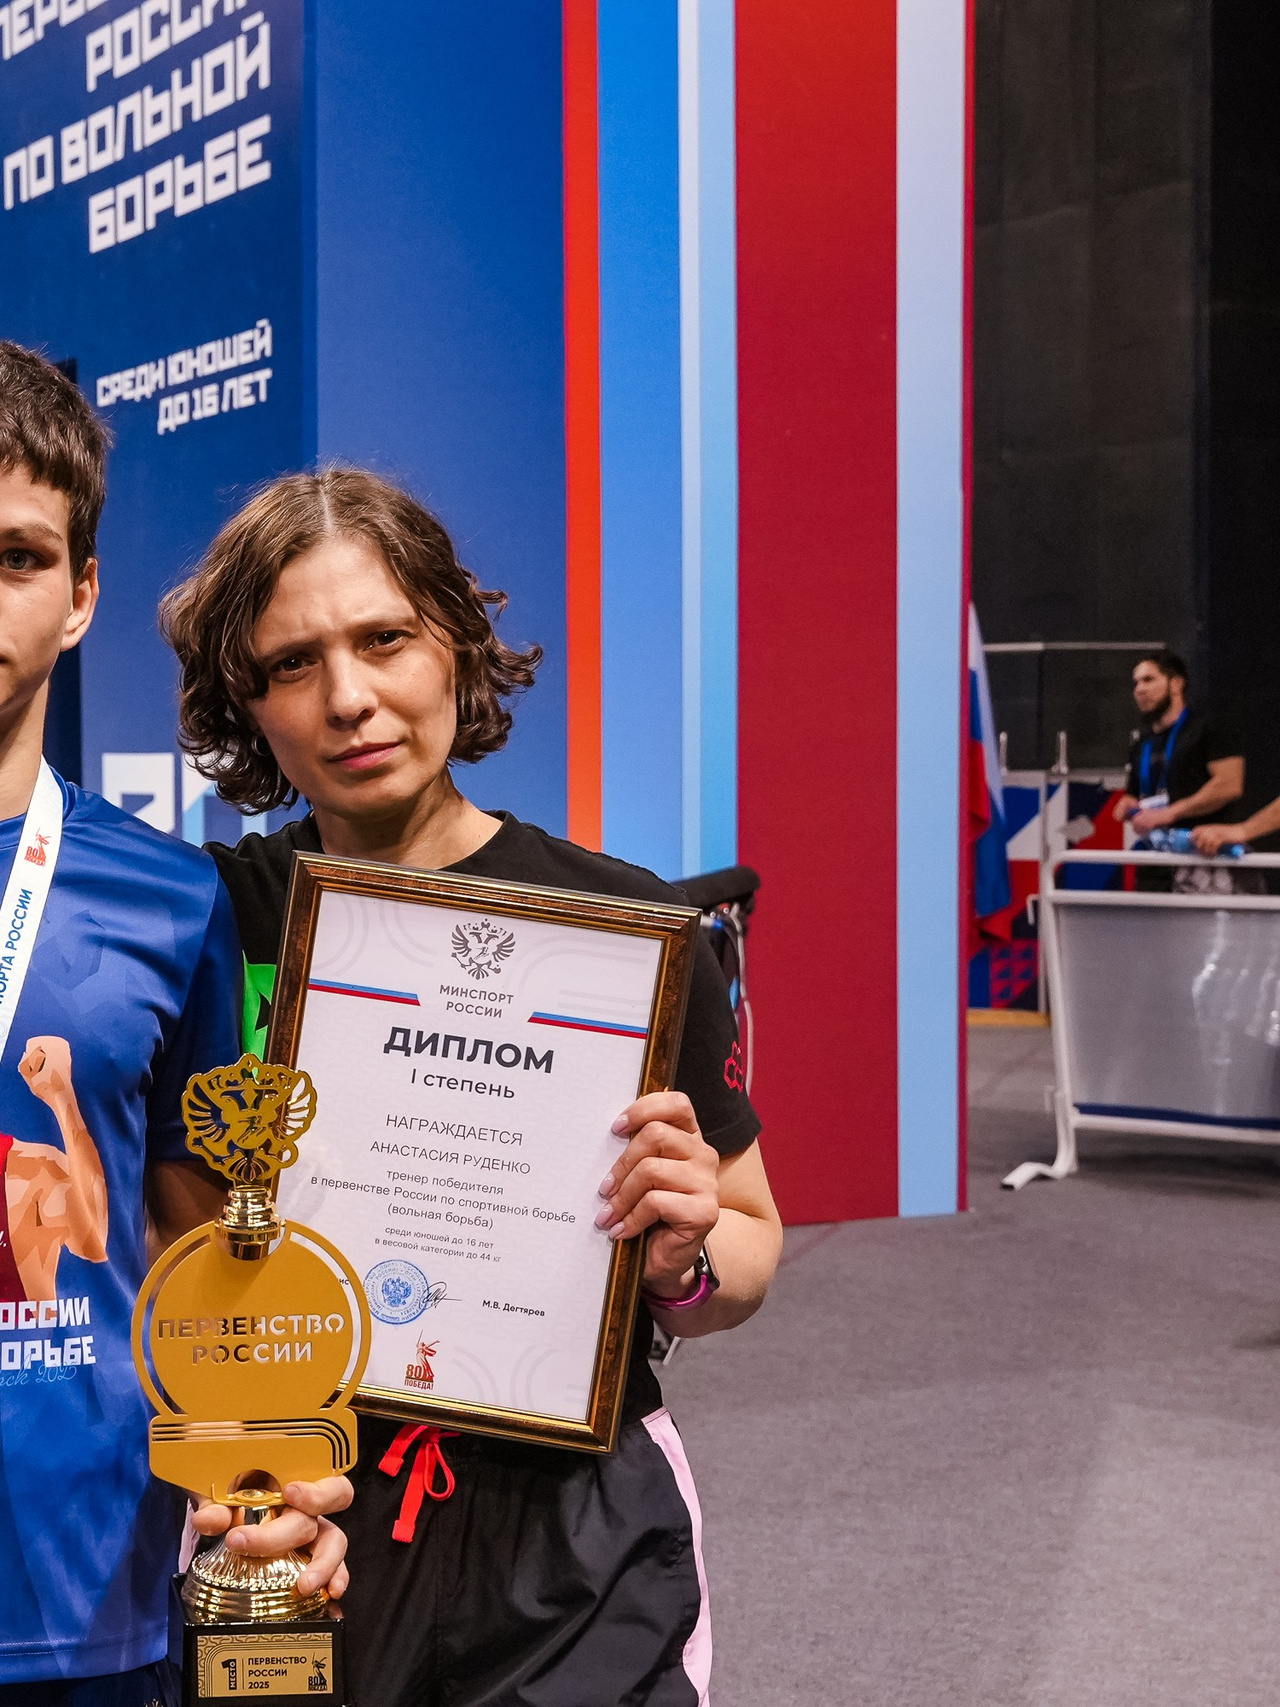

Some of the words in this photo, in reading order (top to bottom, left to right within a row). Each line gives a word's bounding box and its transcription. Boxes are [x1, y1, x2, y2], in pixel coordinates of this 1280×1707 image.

[2, 134, 54, 212] ПО
[60, 12, 270, 184] ВОЛЬНОЙ
[88, 114, 272, 254] БОРЬБЕ
[96, 358, 166, 408] СРЕДИ
[167, 318, 273, 387] ЮНОШЕЙ
[157, 389, 191, 435] ДО
[192, 384, 218, 419] 16
[221, 368, 273, 413] ЛЕТ
[5, 888, 33, 952] РОССИИ
[440, 984, 514, 1005] МИНСПОРТ
[446, 1001, 502, 1019] РОССИИ
[382, 1026, 555, 1074] ДИПЛОМ
[423, 1072, 516, 1099] степень
[386, 1114, 524, 1146] НАГРАЖДАЕТСЯ
[370, 1140, 459, 1164] АНАСТАСИЯ
[463, 1152, 531, 1175] РУДЕНКО
[386, 1169, 428, 1186] тренер
[432, 1175, 504, 1196] победителя
[310, 1176, 318, 1185] в
[320, 1178, 390, 1198] первенстве
[394, 1186, 438, 1204] России
[440, 1195, 455, 1207] по
[458, 1197, 529, 1217] спортивной
[532, 1206, 576, 1224] борьбе
[387, 1202, 442, 1222] (вольная
[444, 1211, 494, 1230] борьба)
[374, 1238, 380, 1246] в
[382, 1238, 419, 1252] весовой
[420, 1244, 464, 1260] категории
[466, 1250, 478, 1261] до
[480, 1252, 491, 1261] 44
[492, 1254, 502, 1264] кг
[384, 1226, 411, 1240] среди
[413, 1228, 449, 1244] юношей
[451, 1235, 464, 1247] до
[466, 1237, 477, 1247] 16
[478, 1240, 494, 1250] лет
[482, 1299, 501, 1311] М.В.
[502, 1302, 546, 1318] Дегтярев
[158, 1312, 345, 1340] ПЕРВЕНСТВО
[192, 1341, 313, 1366] РОССИИ
[37, 1361, 78, 1384] 2025
[404, 1379, 434, 1390] ПОБЕДА!
[406, 1364, 422, 1378] 80
[248, 1656, 307, 1666] ПЕРВЕНСТВО
[248, 1668, 288, 1678] РОССИИ
[248, 1681, 270, 1690] 2025
